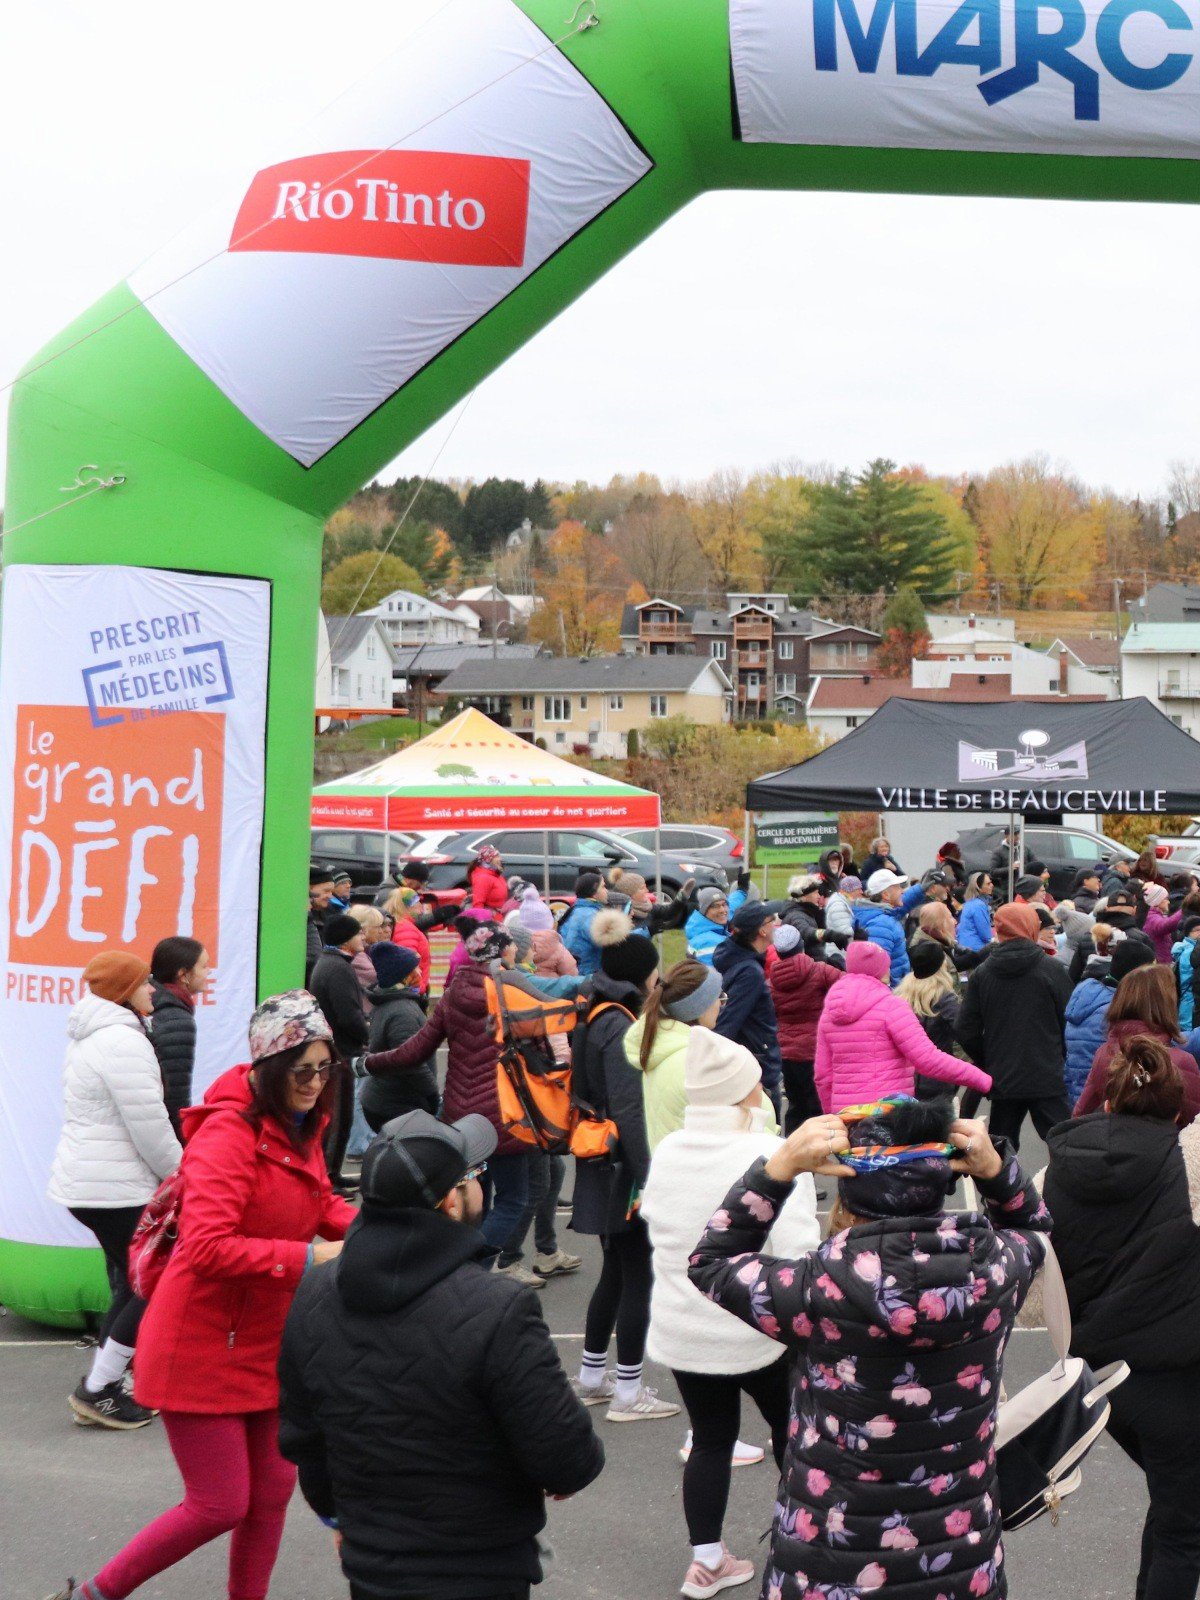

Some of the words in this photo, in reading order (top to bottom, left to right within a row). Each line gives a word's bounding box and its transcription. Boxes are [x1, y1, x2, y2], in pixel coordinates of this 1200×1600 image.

[90, 611, 201, 654] PRESCRIT
[128, 652, 153, 668] PAR
[155, 648, 177, 662] LES
[99, 662, 217, 706] MÉDECINS
[131, 708, 147, 722] DE
[150, 697, 200, 717] FAMILLE
[28, 721, 54, 756] le
[24, 747, 205, 825] grand
[876, 787, 949, 809] VILLE
[955, 793, 982, 809] DE
[989, 789, 1168, 811] BEAUCEVILLE
[424, 808, 452, 819] Santé
[466, 807, 506, 818] sécurité
[508, 809, 520, 817] au
[552, 807, 565, 816] de
[567, 807, 583, 816] nos
[586, 806, 628, 818] quartiers
[757, 828, 784, 838] CERCLE
[785, 828, 795, 836] DE
[796, 825, 838, 835] FERMIÈRES
[773, 835, 822, 845] BEAUCEVILLE
